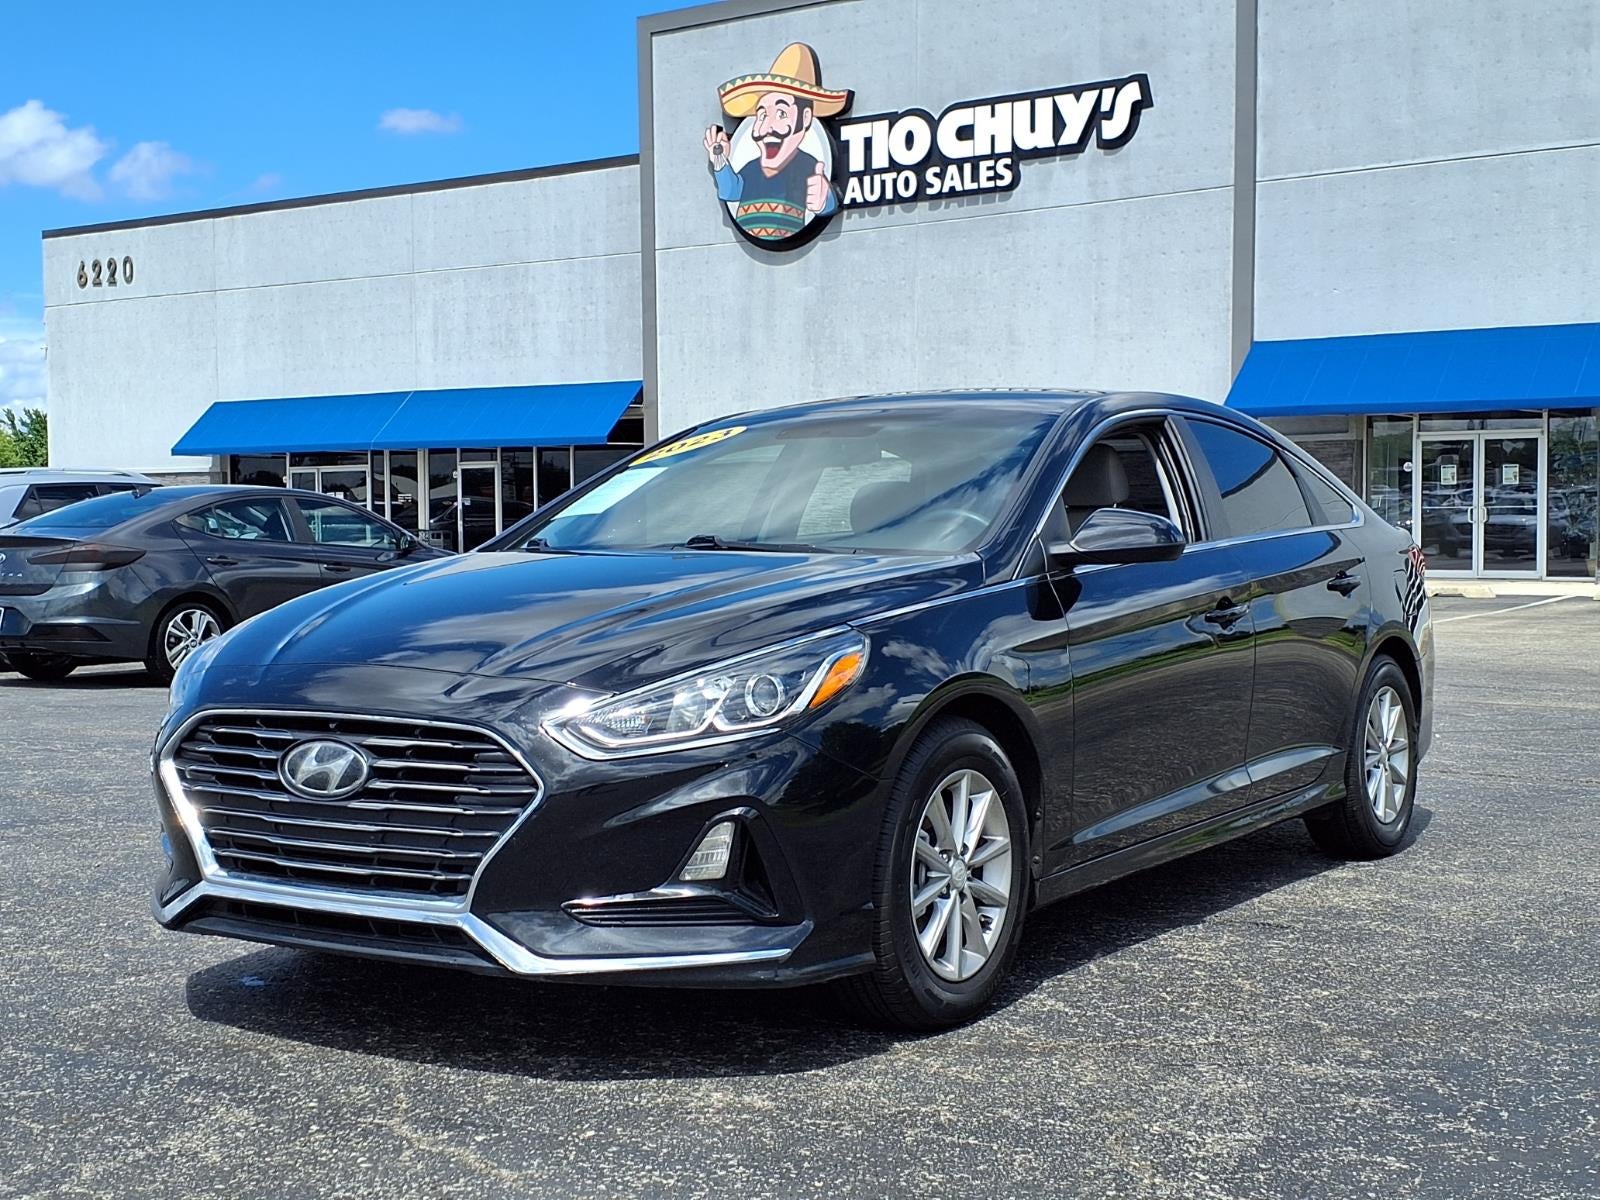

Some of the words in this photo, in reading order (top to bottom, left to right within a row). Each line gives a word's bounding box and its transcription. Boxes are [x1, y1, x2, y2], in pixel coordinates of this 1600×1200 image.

[840, 115, 932, 172] TIO
[936, 81, 1143, 160] CHUY'S
[843, 169, 918, 205] AUTO
[925, 158, 1014, 196] SALES
[77, 255, 134, 289] 6220
